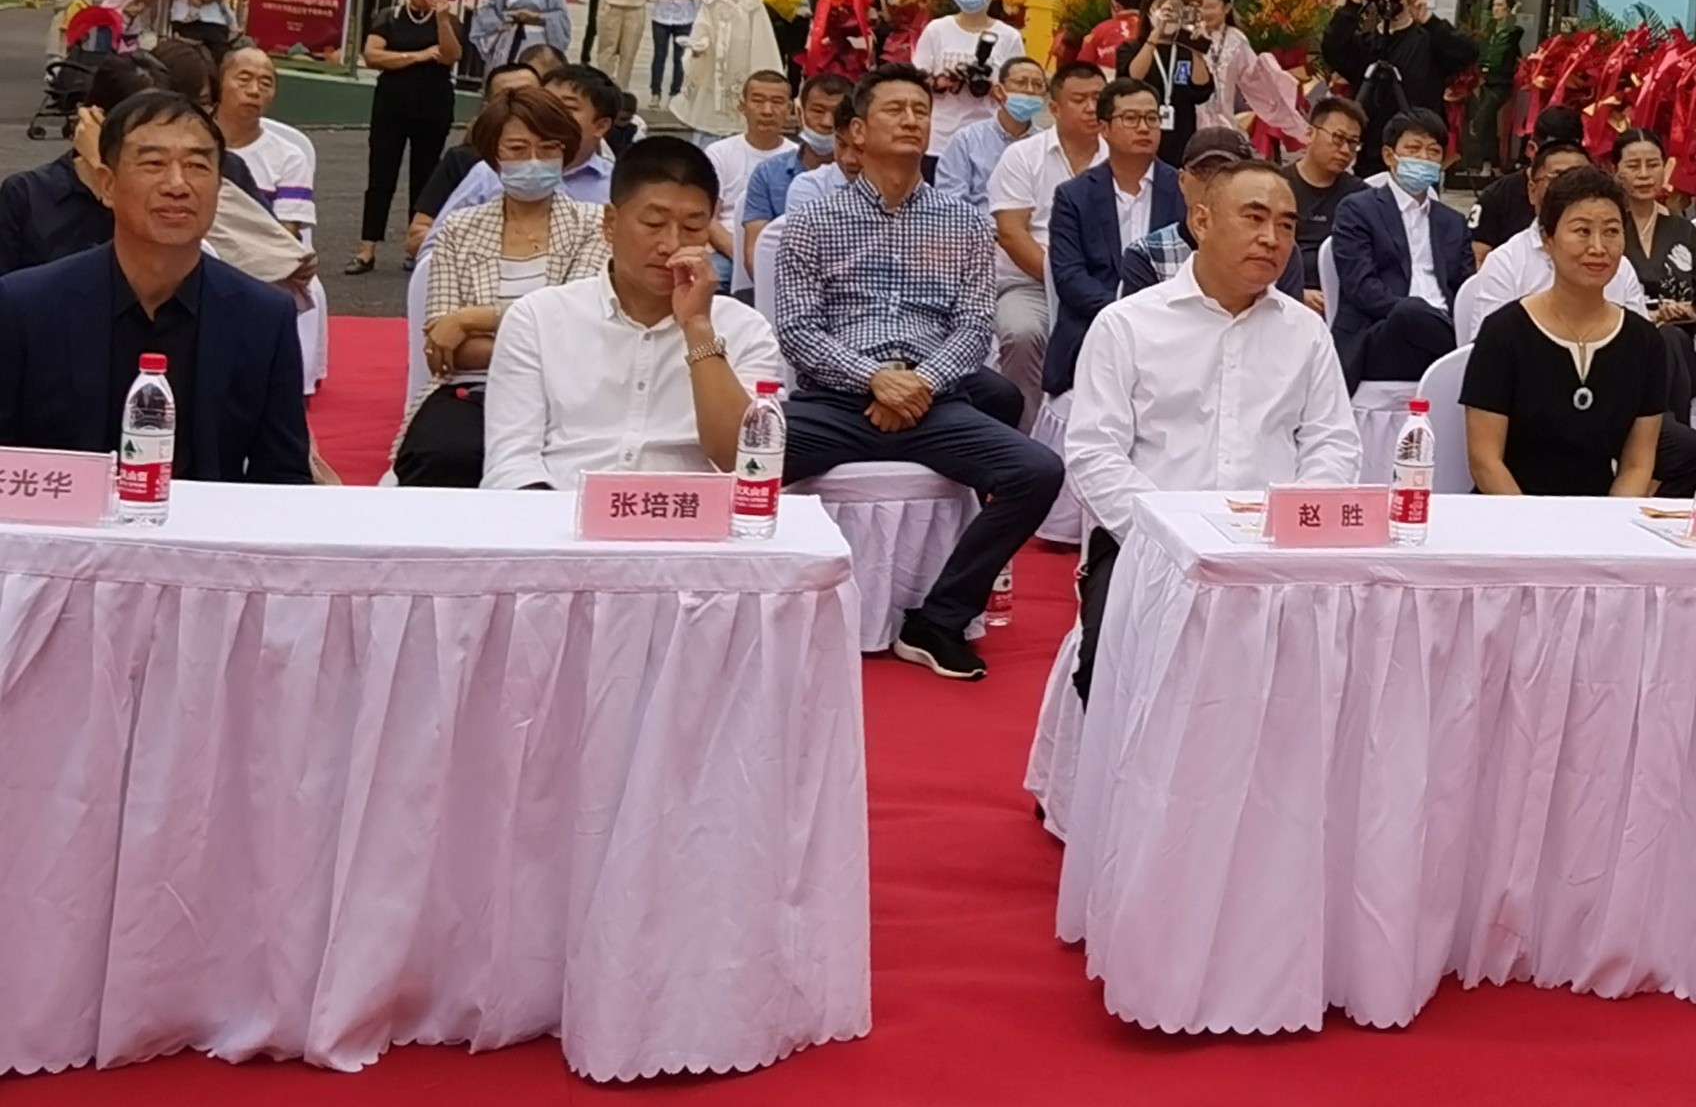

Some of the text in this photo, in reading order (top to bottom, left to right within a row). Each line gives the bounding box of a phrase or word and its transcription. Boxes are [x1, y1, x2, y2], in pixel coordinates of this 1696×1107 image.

[0, 469, 73, 499] 光华
[609, 492, 700, 519] 张培潜
